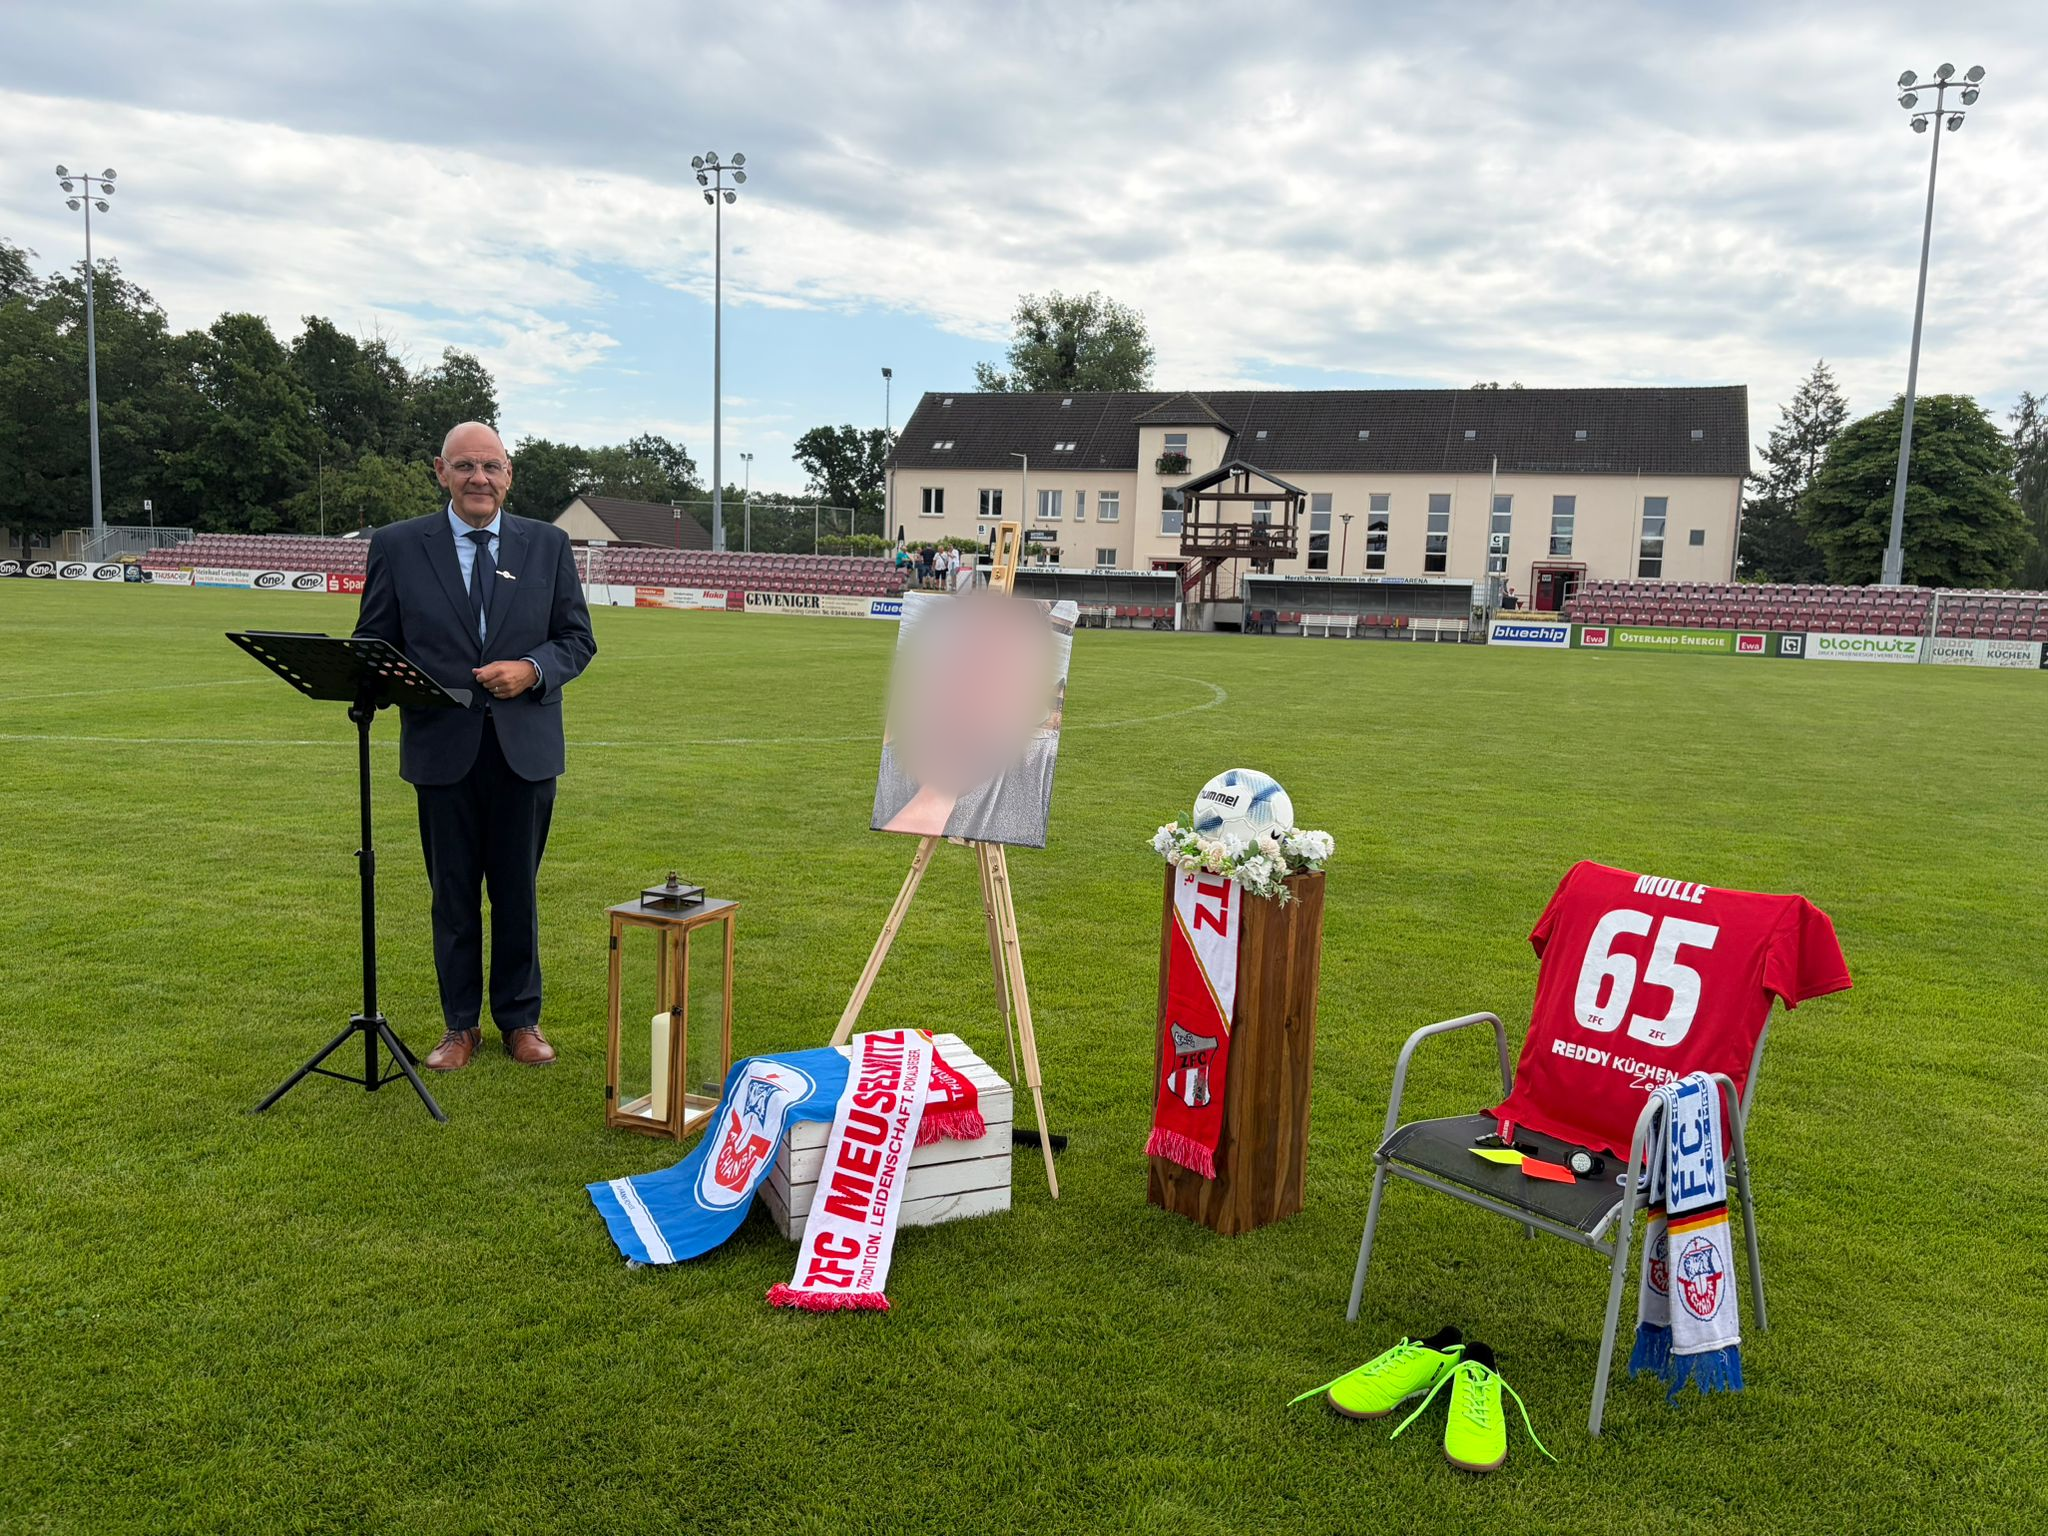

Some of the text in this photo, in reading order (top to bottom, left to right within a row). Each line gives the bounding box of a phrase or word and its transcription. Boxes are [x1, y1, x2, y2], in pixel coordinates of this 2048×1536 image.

[1314, 575, 1357, 583] Willkommen
[746, 592, 820, 609] GEWENIGER
[1494, 627, 1565, 641] bluechip
[1819, 637, 1917, 653] blochwitz
[1987, 650, 2031, 660] KÜCHEN
[1573, 909, 1720, 1047] 65
[1587, 1013, 1604, 1026] ZFC
[1648, 1028, 1667, 1042] ZFC
[1179, 1052, 1207, 1068] ZFC
[1551, 1038, 1680, 1083] REDDY KÜCHEN
[802, 1031, 905, 1288] ZFC MEUSELWITZ
[856, 1048, 921, 1290] TRADITION. LEIDENSCHAFT. POKALSIEGER.
